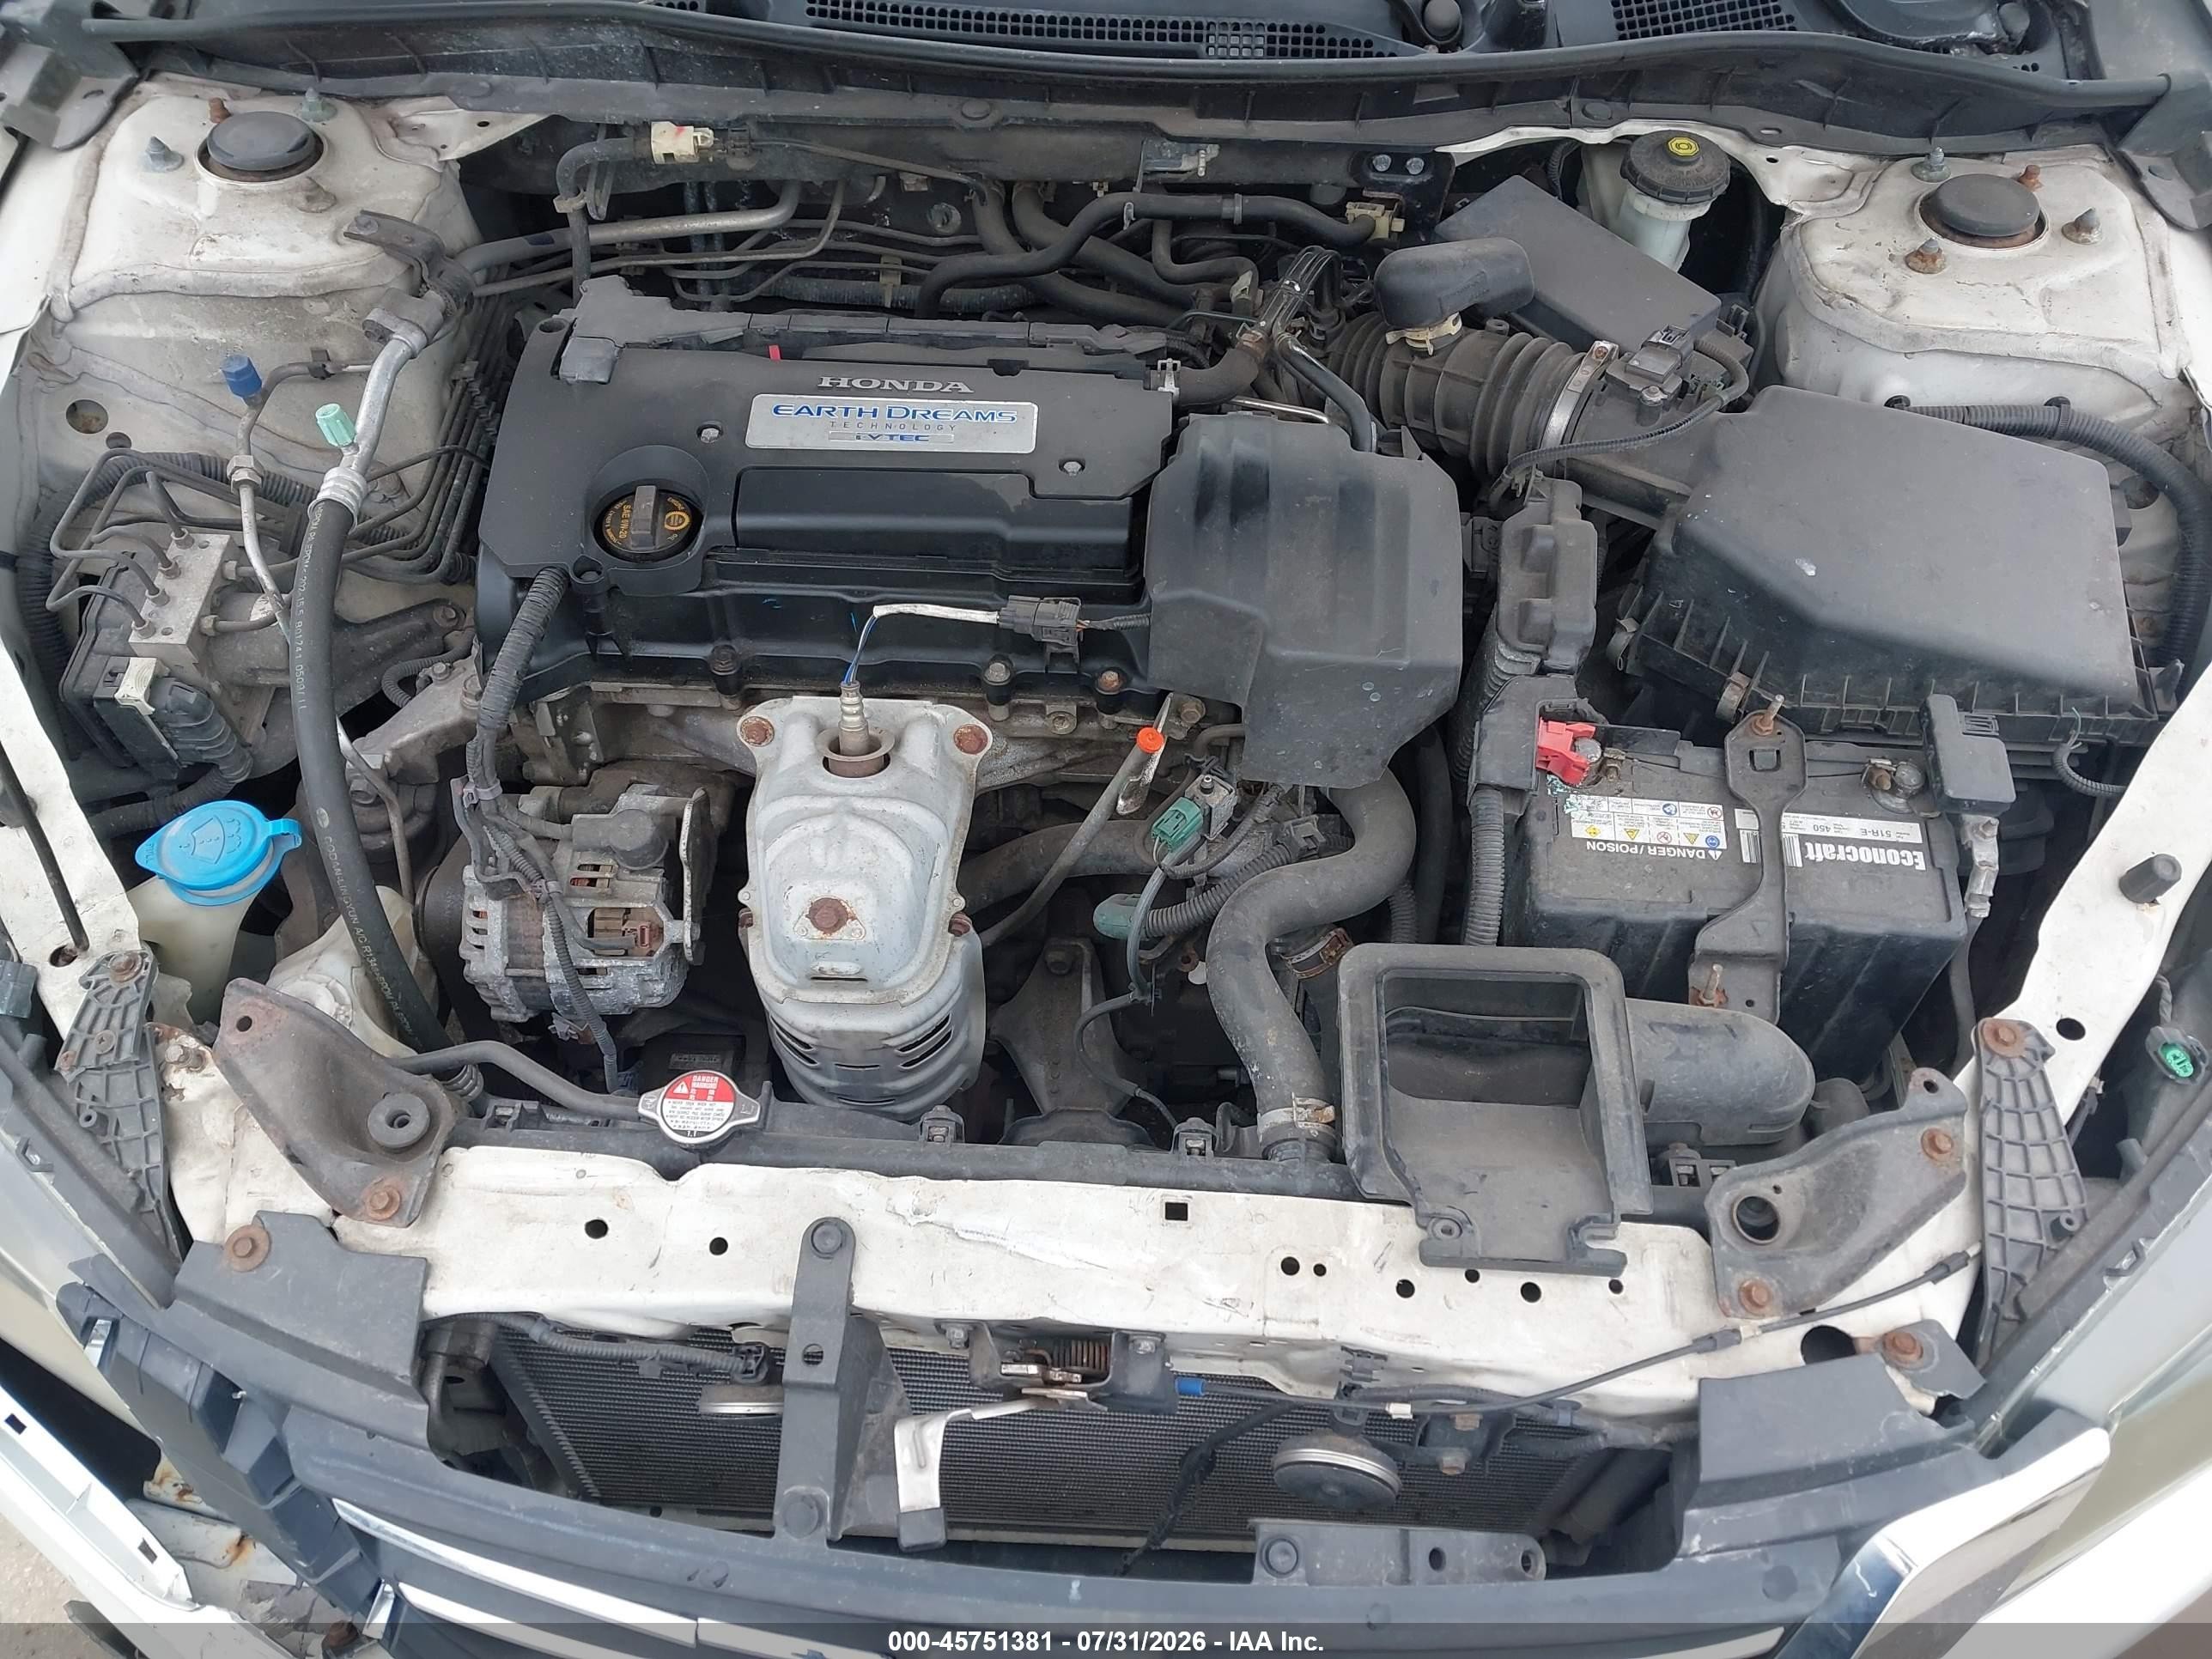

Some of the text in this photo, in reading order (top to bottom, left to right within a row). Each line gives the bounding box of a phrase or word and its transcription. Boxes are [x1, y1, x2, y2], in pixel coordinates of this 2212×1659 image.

[817, 376, 975, 393] HONDA
[773, 404, 1018, 422] EARTH DREAMS
[830, 421, 956, 431] TECHNOLOGY
[622, 504, 631, 519] SAE
[1861, 828, 1892, 838] 51R-E
[1586, 841, 1638, 855] POISON
[1648, 844, 1706, 858] DANGER
[1805, 842, 1927, 871] Econocraft
